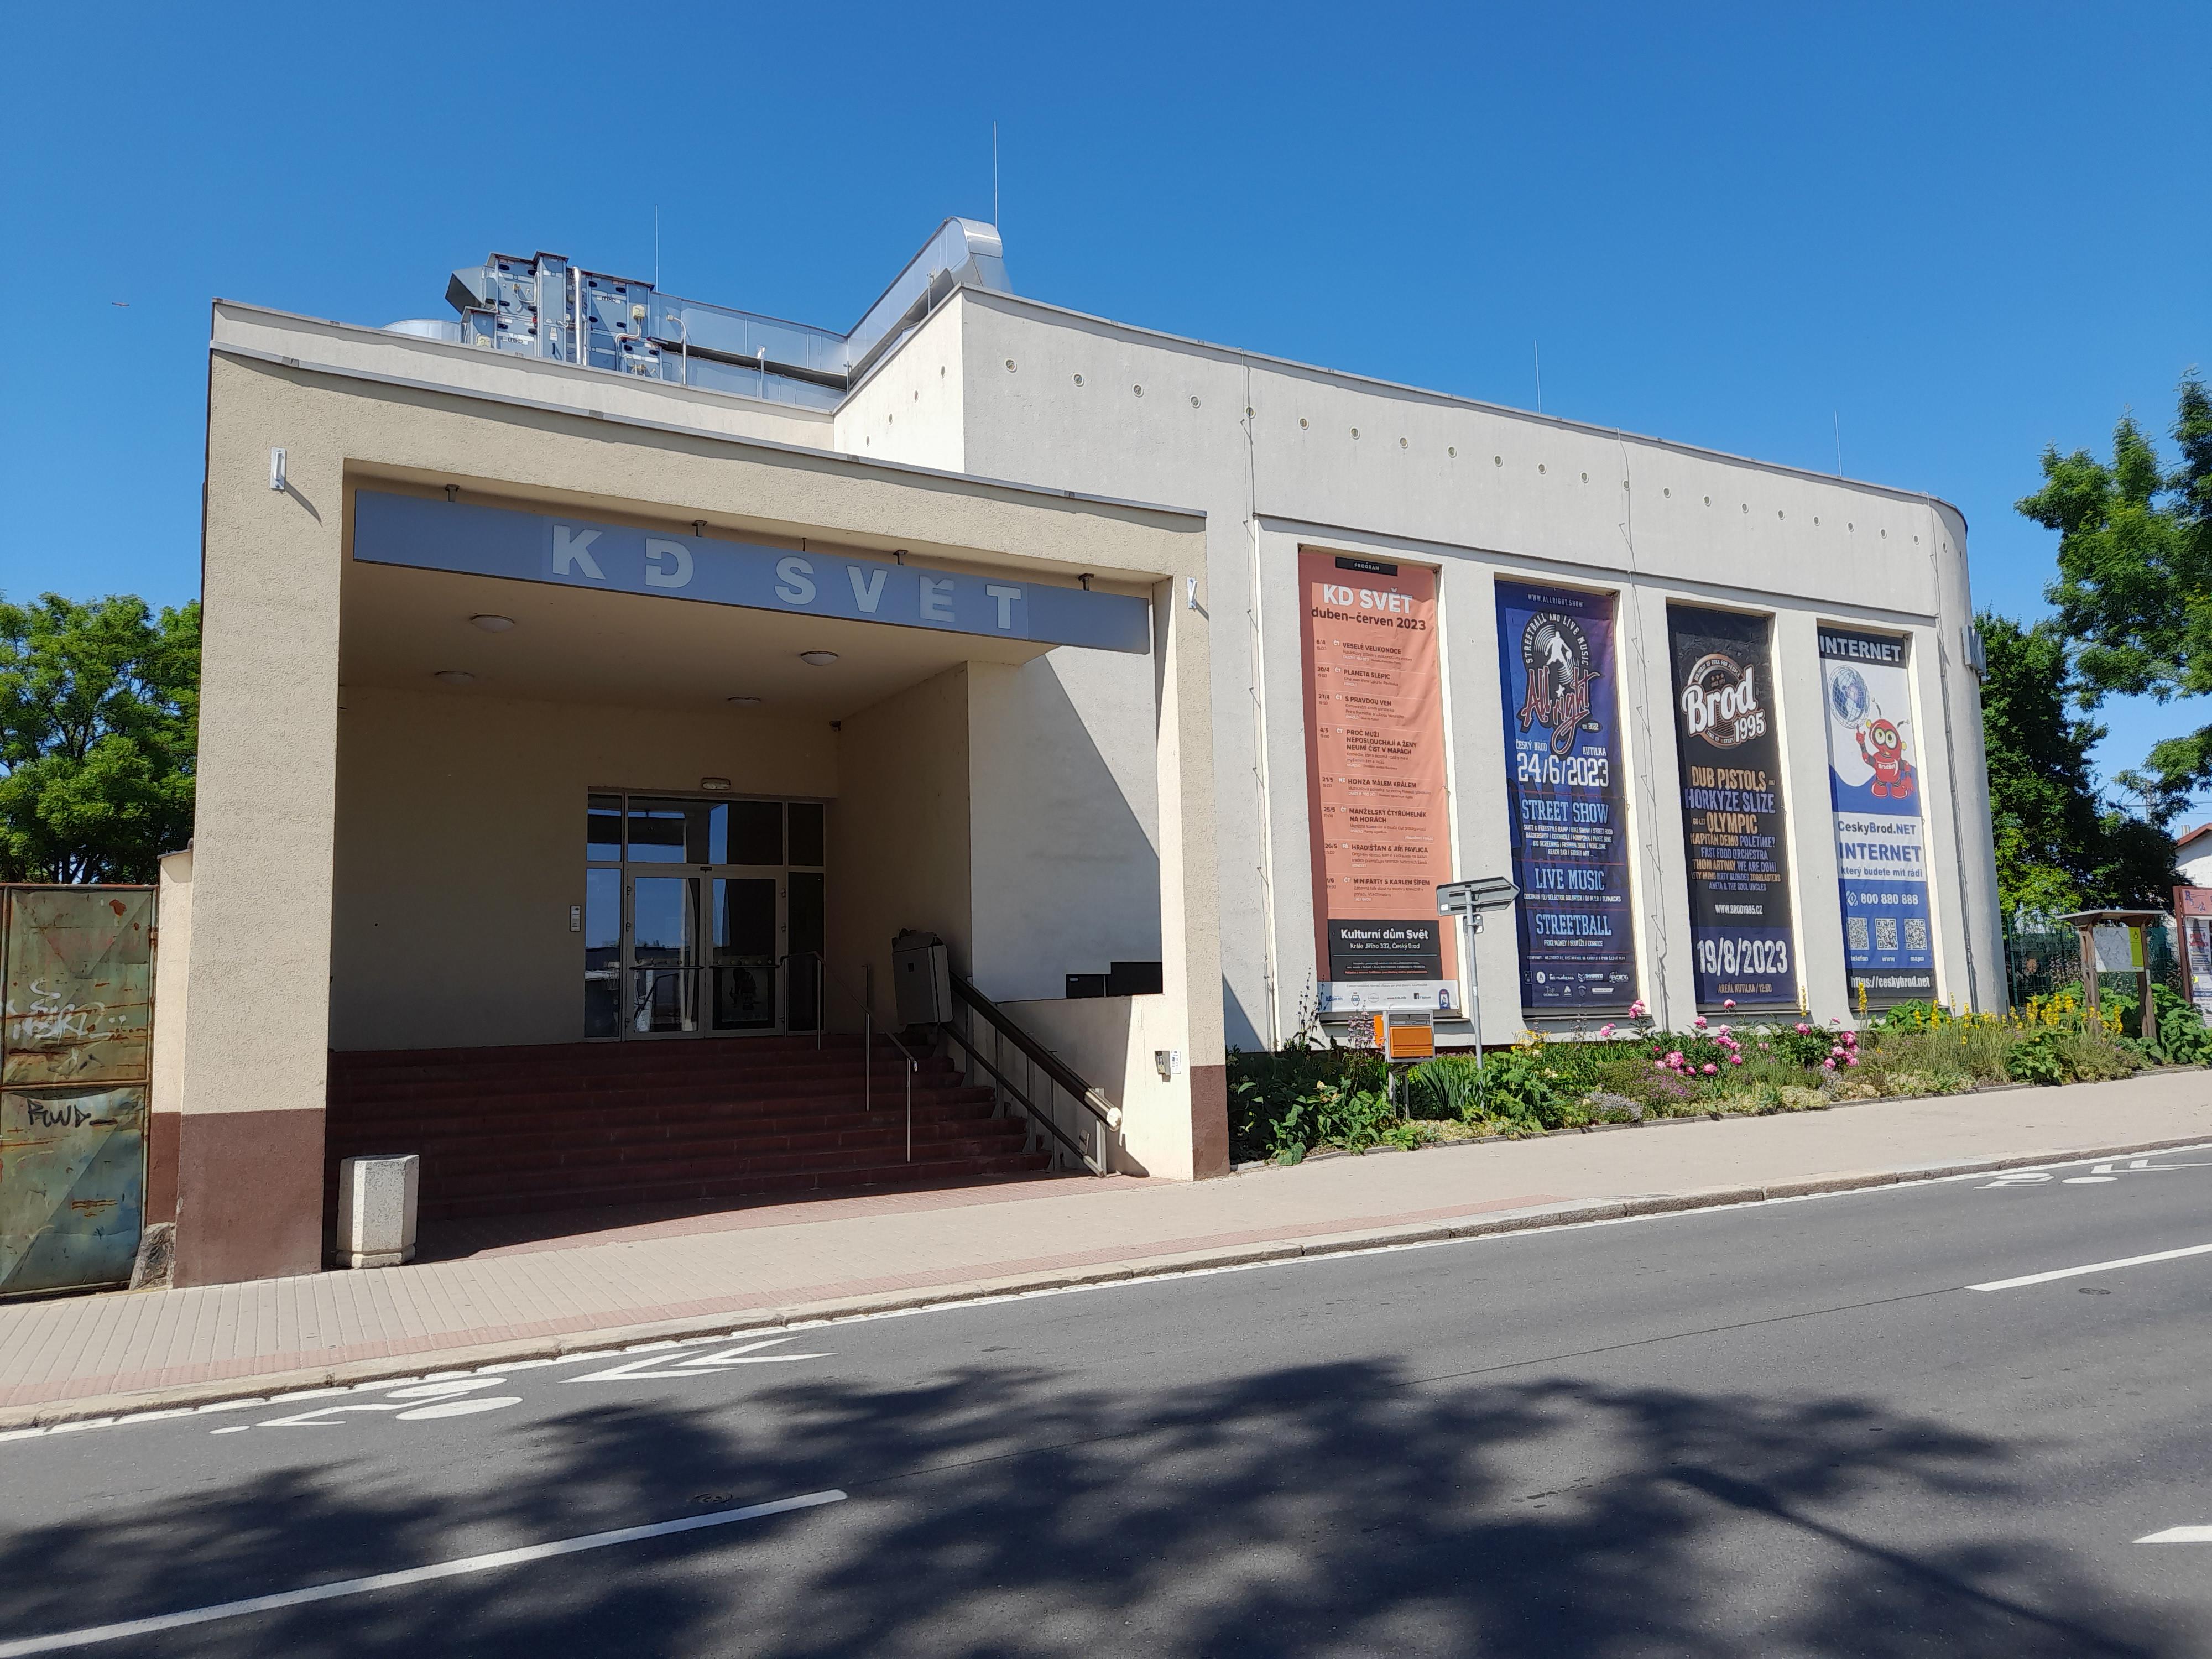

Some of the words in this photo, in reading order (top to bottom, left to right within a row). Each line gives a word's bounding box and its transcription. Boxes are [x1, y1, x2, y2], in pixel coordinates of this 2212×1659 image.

[1354, 562, 1380, 571] PROGRAM
[1322, 583, 1354, 606] KD
[1359, 587, 1413, 614] SVĚT
[1527, 593, 1584, 608] WWW.ALLRIGHT.SHOW
[1396, 617, 1427, 631] 2023
[1525, 613, 1547, 664] STREETBALL
[1549, 613, 1561, 622] AND
[1563, 615, 1580, 635] LIVE
[1577, 635, 1589, 666] MUSIC
[1342, 642, 1364, 650] VESELÉ
[1365, 645, 1402, 655] VELIKONOCE
[1819, 635, 1902, 662] INTERNET
[1344, 669, 1370, 677] PLANETA
[1350, 696, 1379, 705] PRAVDOU
[1682, 667, 1757, 735] Brod
[1734, 712, 1765, 743] 1995
[1346, 737, 1396, 747] NEPOSLOUCHAJÍ
[1402, 740, 1417, 748] ŽENY
[1515, 738, 1532, 750] ČESKÝ
[1533, 742, 1548, 752] BROD
[1387, 746, 1412, 755] MAPÁCH
[1582, 745, 1607, 757] KUTILKA
[1516, 752, 1609, 787] 24/6/2023
[1371, 779, 1392, 787] MÁLEM
[1393, 780, 1417, 789] KRÁLEM
[1691, 765, 1715, 788] DUB
[1716, 767, 1767, 792] PISTOLS
[1349, 807, 1386, 816] MANŽELSKÝ
[1522, 799, 1569, 822] STREET
[1572, 802, 1610, 824] SHOW
[1705, 811, 1758, 834] OLYMPIC
[1838, 820, 1916, 835] CeskyBrod.NET
[1351, 843, 1386, 852] HRADIŠŤAN
[1720, 834, 1739, 847] DEMO
[1739, 833, 1776, 848] POLETÍME?
[1700, 847, 1715, 858] FAST
[1716, 847, 1732, 859] FOOD
[1733, 848, 1768, 860] ORCHESTRA
[1839, 842, 1922, 862] INTERNET
[1692, 859, 1713, 870] THOM
[1713, 860, 1736, 872] ARTWAY
[1736, 860, 1747, 872] WE
[1748, 861, 1760, 872] ARE
[1761, 862, 1777, 873] DOMI
[1840, 865, 1862, 877] který
[1864, 866, 1891, 877] budete
[1893, 867, 1906, 877] mít
[1907, 868, 1923, 878] rádi
[1535, 868, 1564, 890] LIVE
[1568, 868, 1605, 891] MUSIC
[1728, 882, 1737, 891] THE
[1860, 893, 1879, 904] 800
[1881, 893, 1899, 905] 880
[1901, 894, 1919, 905] 888
[1715, 904, 1764, 915] WWW.BROD1995.CZ
[1536, 914, 1612, 936] STREETBALL
[1340, 928, 1381, 940] Kulturní
[1383, 928, 1405, 939] dům
[1406, 929, 1429, 940] Svět
[1697, 937, 1788, 977] 19/8/2023
[1718, 981, 1734, 993] AREÁL
[1734, 983, 1756, 993] KUTILKA
[1759, 983, 1772, 993] 12:00
[1850, 975, 1931, 989] https://ceskybrod.net
